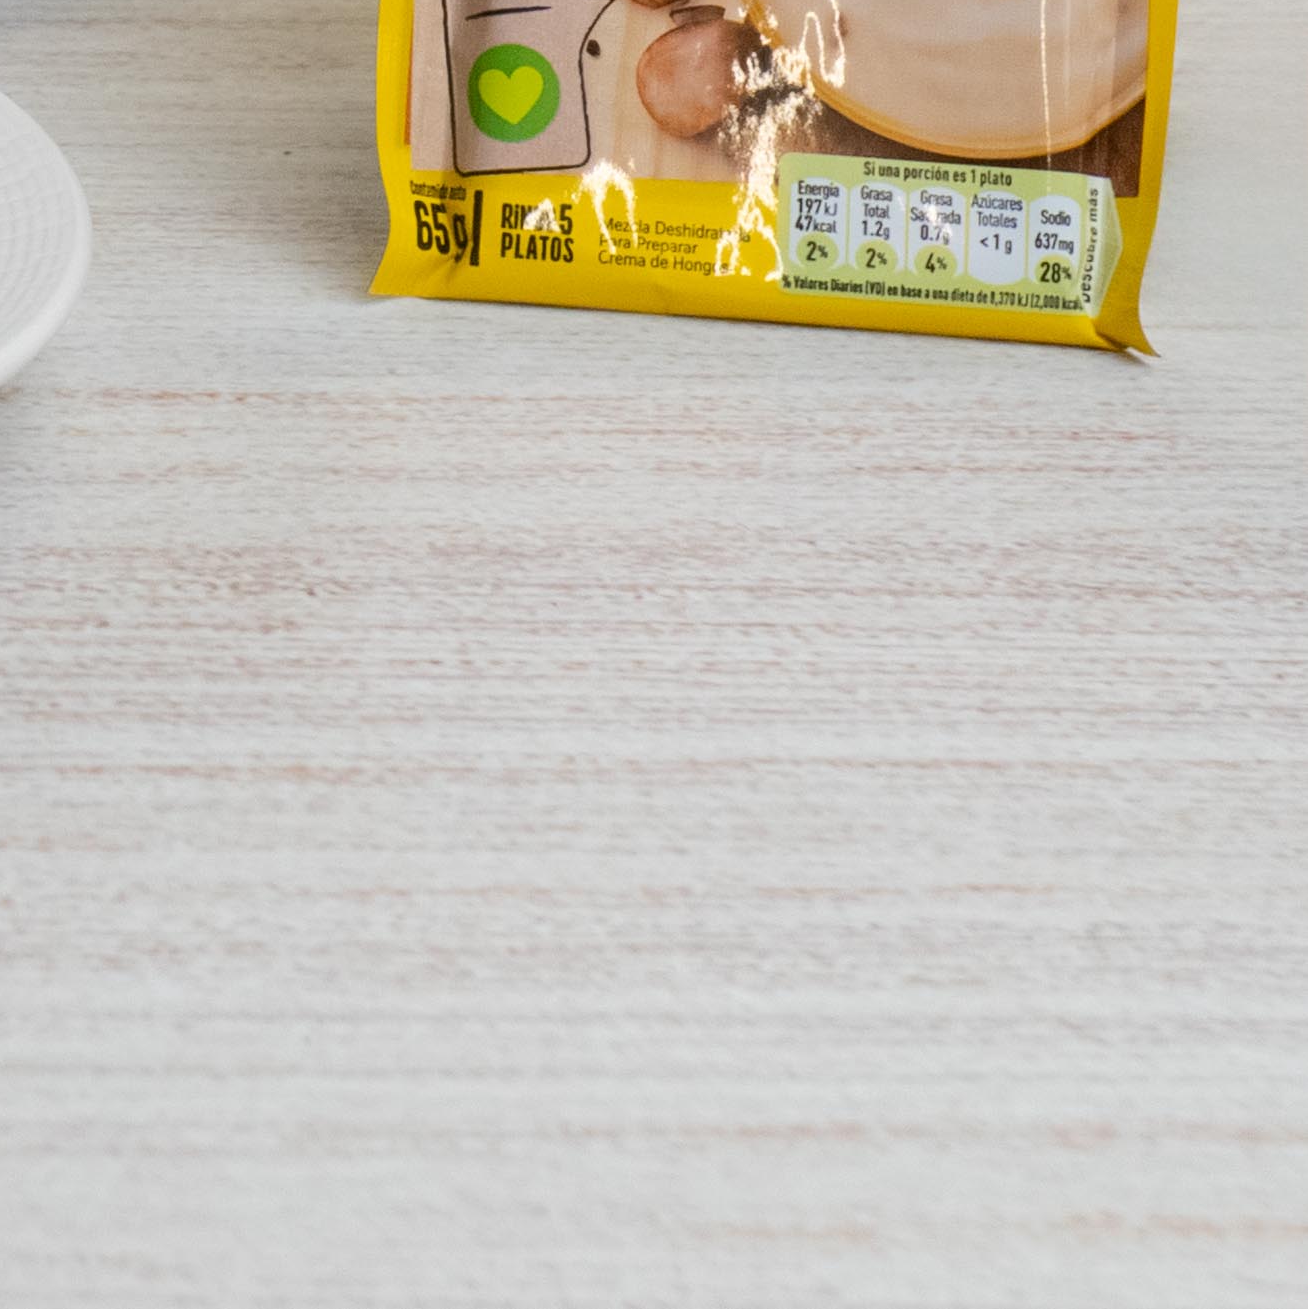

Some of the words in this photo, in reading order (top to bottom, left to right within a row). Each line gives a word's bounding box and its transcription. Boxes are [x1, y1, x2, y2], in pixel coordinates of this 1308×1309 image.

[863, 161, 876, 176] Si
[879, 166, 900, 177] una
[903, 166, 950, 181] porción
[953, 171, 967, 182] es
[971, 170, 976, 183] 1
[980, 170, 1013, 187] plato
[860, 185, 893, 202] Grasa
[920, 190, 952, 207] Grasa
[971, 194, 1023, 211] Azúcares
[797, 198, 822, 214] 197
[863, 204, 890, 219] Total
[559, 204, 573, 235] 5
[910, 207, 961, 225] Sarada
[977, 212, 1018, 229] Totales
[1040, 209, 1071, 226] Sodio
[602, 218, 650, 233] Mezla
[500, 232, 574, 263] PLATOS
[637, 236, 698, 255] Preparar
[806, 241, 829, 262] 2%
[598, 250, 646, 267] Crema
[650, 256, 669, 268] de
[865, 248, 887, 269] 2%
[925, 252, 947, 273] 4%
[1080, 226, 1098, 304] Descubre
[1040, 262, 1072, 284] 28%
[793, 276, 828, 291] Valores
[888, 285, 899, 296] en
[901, 284, 922, 298] base
[933, 290, 948, 300] una
[951, 288, 974, 303] dieta
[976, 291, 988, 303] de
